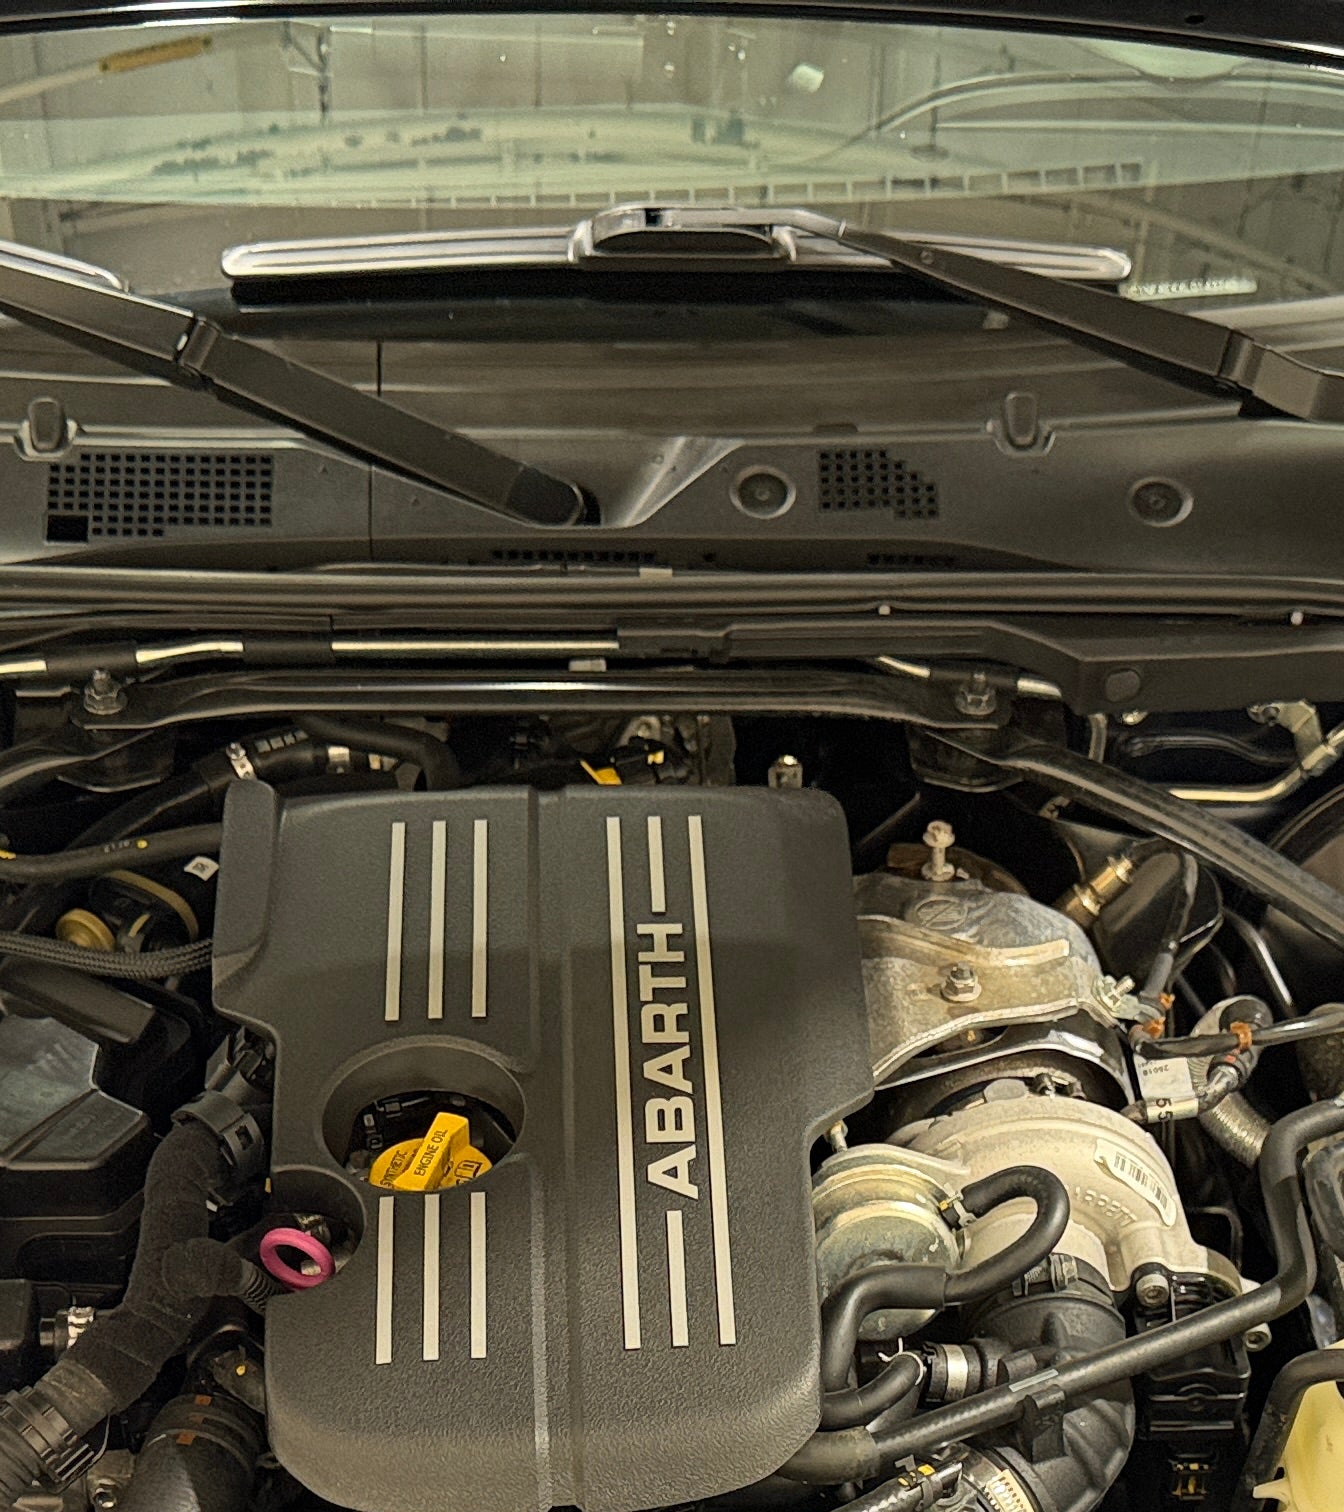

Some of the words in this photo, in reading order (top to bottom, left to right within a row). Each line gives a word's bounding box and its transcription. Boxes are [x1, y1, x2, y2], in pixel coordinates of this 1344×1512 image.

[636, 922, 699, 1201] ABARTH
[413, 1143, 440, 1177] ENGINE
[430, 1128, 449, 1144] OIL
